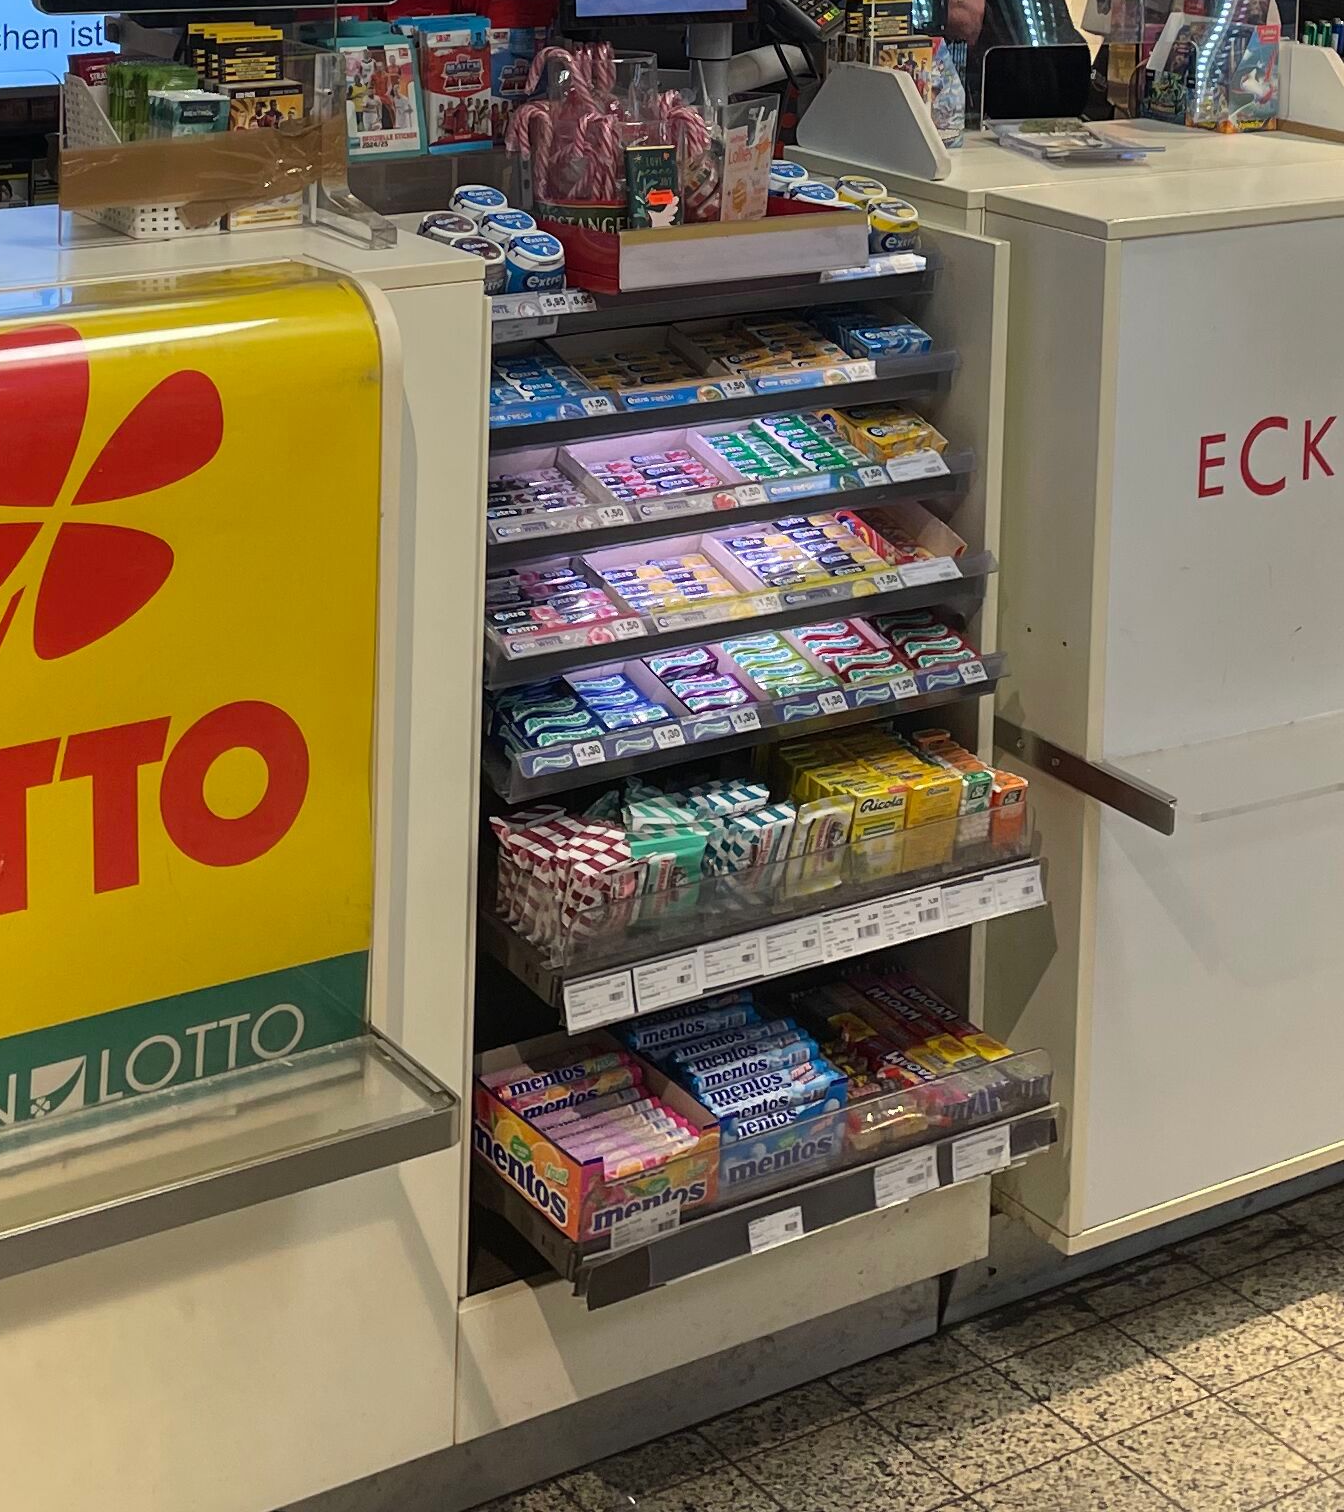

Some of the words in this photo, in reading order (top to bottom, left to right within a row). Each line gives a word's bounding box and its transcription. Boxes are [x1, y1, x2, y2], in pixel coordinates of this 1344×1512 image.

[70, 20, 104, 48] ist
[860, 795, 903, 813] Ricola
[866, 988, 923, 1022] MAOAM
[903, 987, 959, 1021] MAOAM
[641, 1019, 705, 1045] mentos
[683, 1030, 744, 1057] mentos
[87, 1001, 305, 1117] LOTTO
[694, 1044, 758, 1071] mentos
[704, 1057, 768, 1087] mentos
[509, 1065, 586, 1096] mentos
[709, 1071, 783, 1103] mentos
[727, 1135, 833, 1183] mentos
[475, 1125, 567, 1225] mentos
